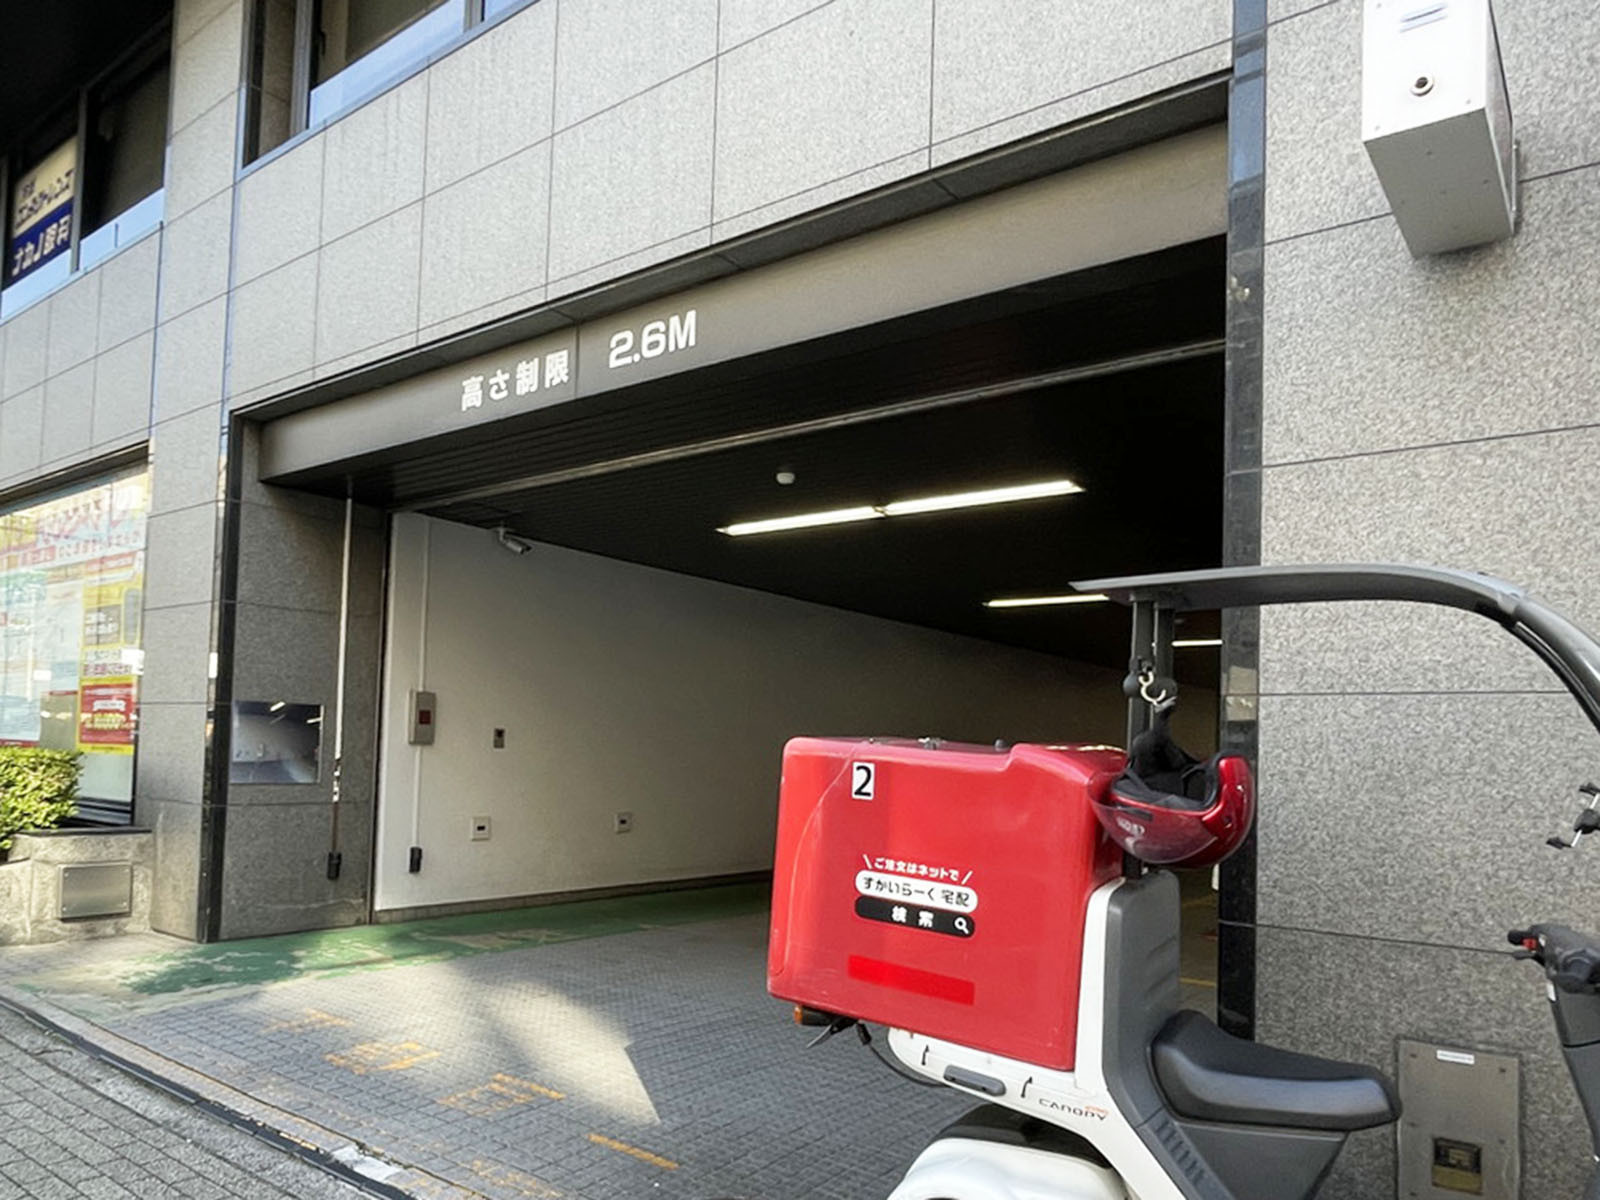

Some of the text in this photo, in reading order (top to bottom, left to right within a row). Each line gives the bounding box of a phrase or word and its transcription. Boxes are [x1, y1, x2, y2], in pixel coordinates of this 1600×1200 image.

[461, 309, 697, 411] 高さ制限 2.6M
[853, 765, 872, 797] 2
[874, 858, 959, 881] ご注文はネットで
[863, 877, 971, 907] すかいらーく 宅配
